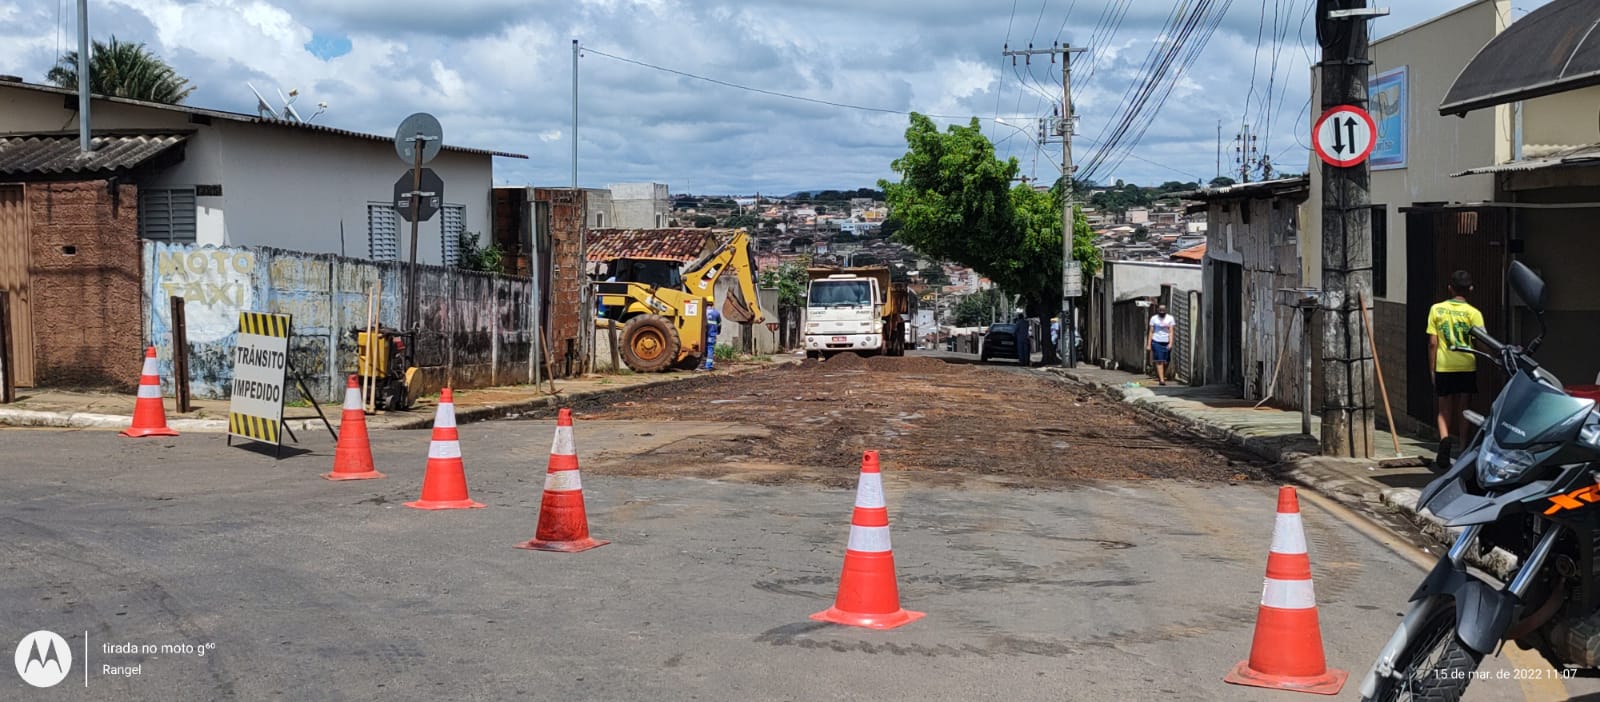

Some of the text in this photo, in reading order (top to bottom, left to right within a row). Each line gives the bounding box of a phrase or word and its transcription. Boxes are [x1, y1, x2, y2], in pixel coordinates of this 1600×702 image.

[159, 250, 255, 275] MOTO
[160, 282, 244, 306] TAXI
[237, 344, 285, 370] TRÂNSITO
[233, 378, 280, 403] IMPEDIDO
[1501, 421, 1526, 437] HONDA
